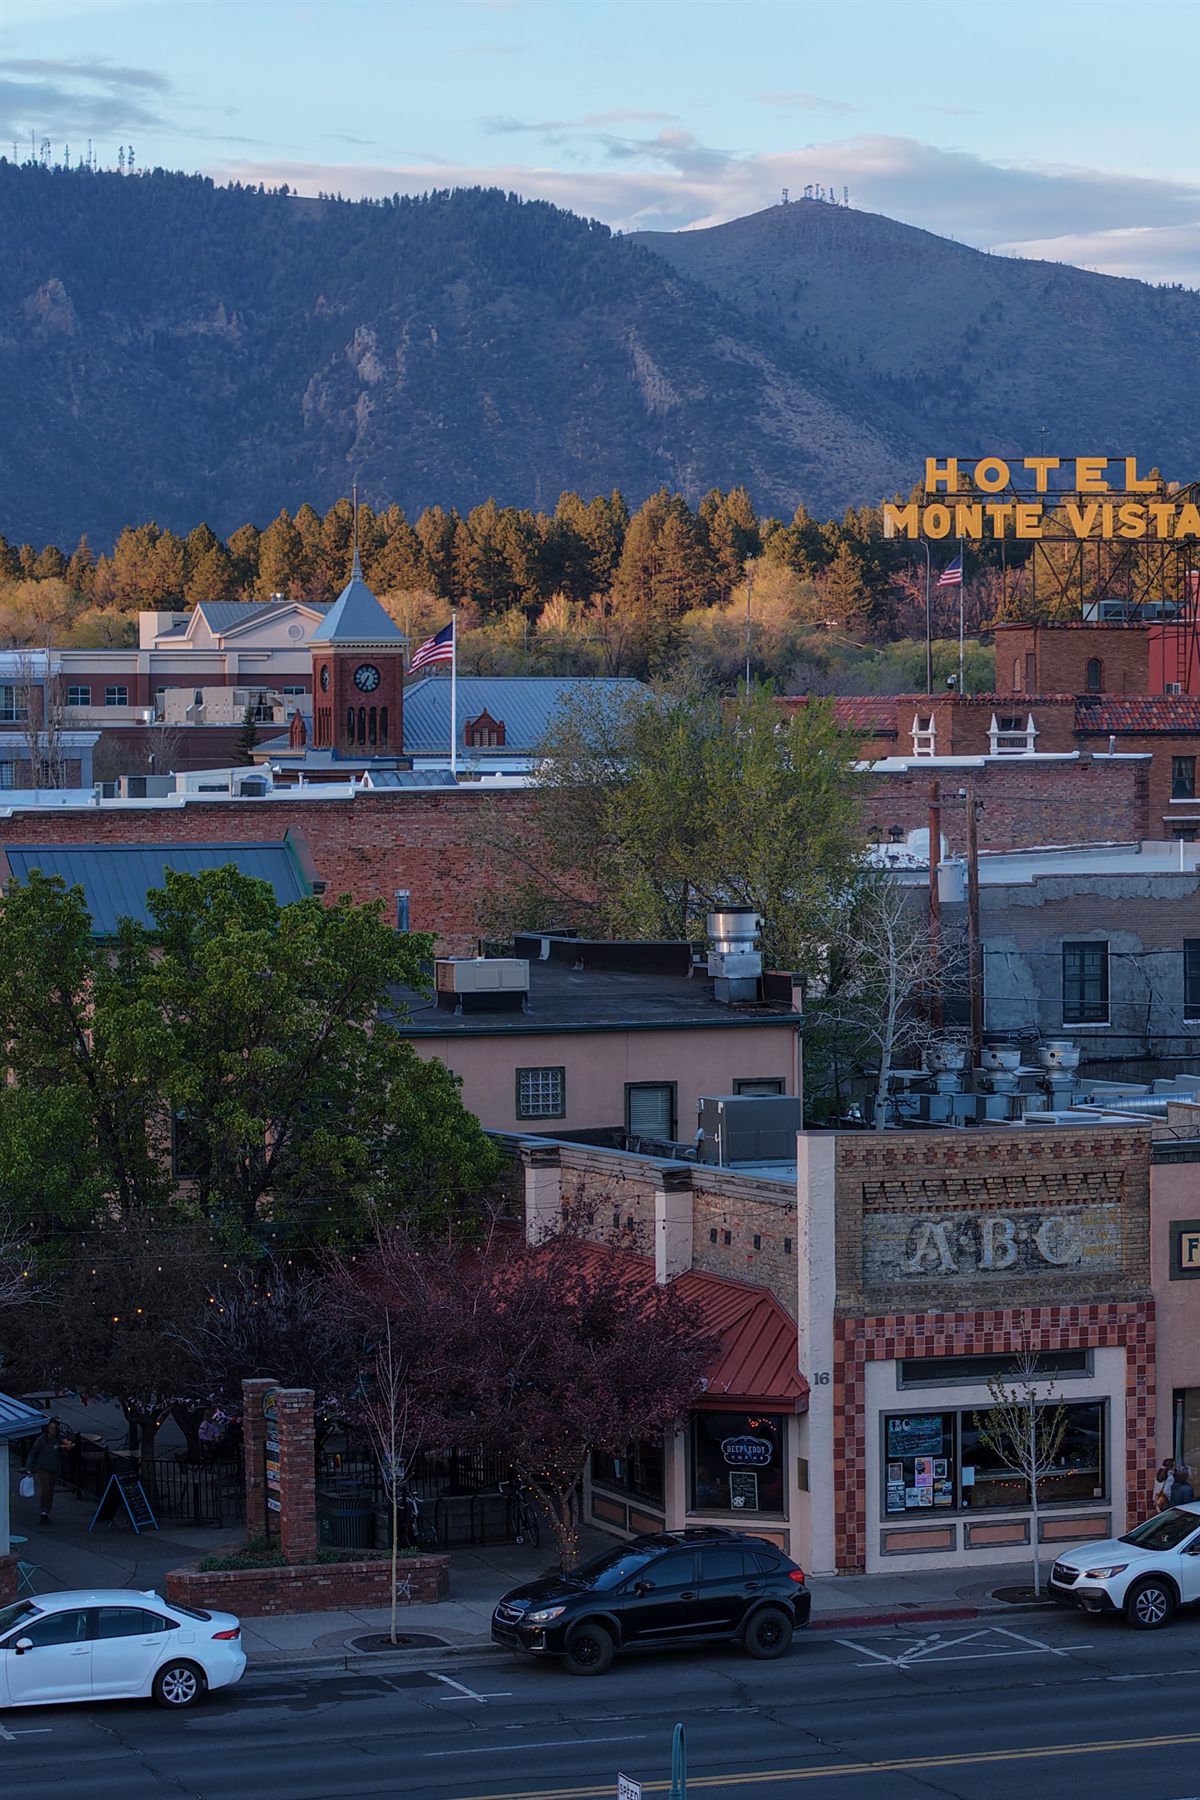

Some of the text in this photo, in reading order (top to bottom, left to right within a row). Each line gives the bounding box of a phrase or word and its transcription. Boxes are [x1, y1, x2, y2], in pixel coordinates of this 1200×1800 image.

[925, 457, 1158, 493] HOTEL
[883, 503, 1043, 540] MONTE
[813, 1371, 830, 1386] 16
[726, 1445, 766, 1454] DEEP EDDY
[619, 1783, 639, 1800] SPEED
